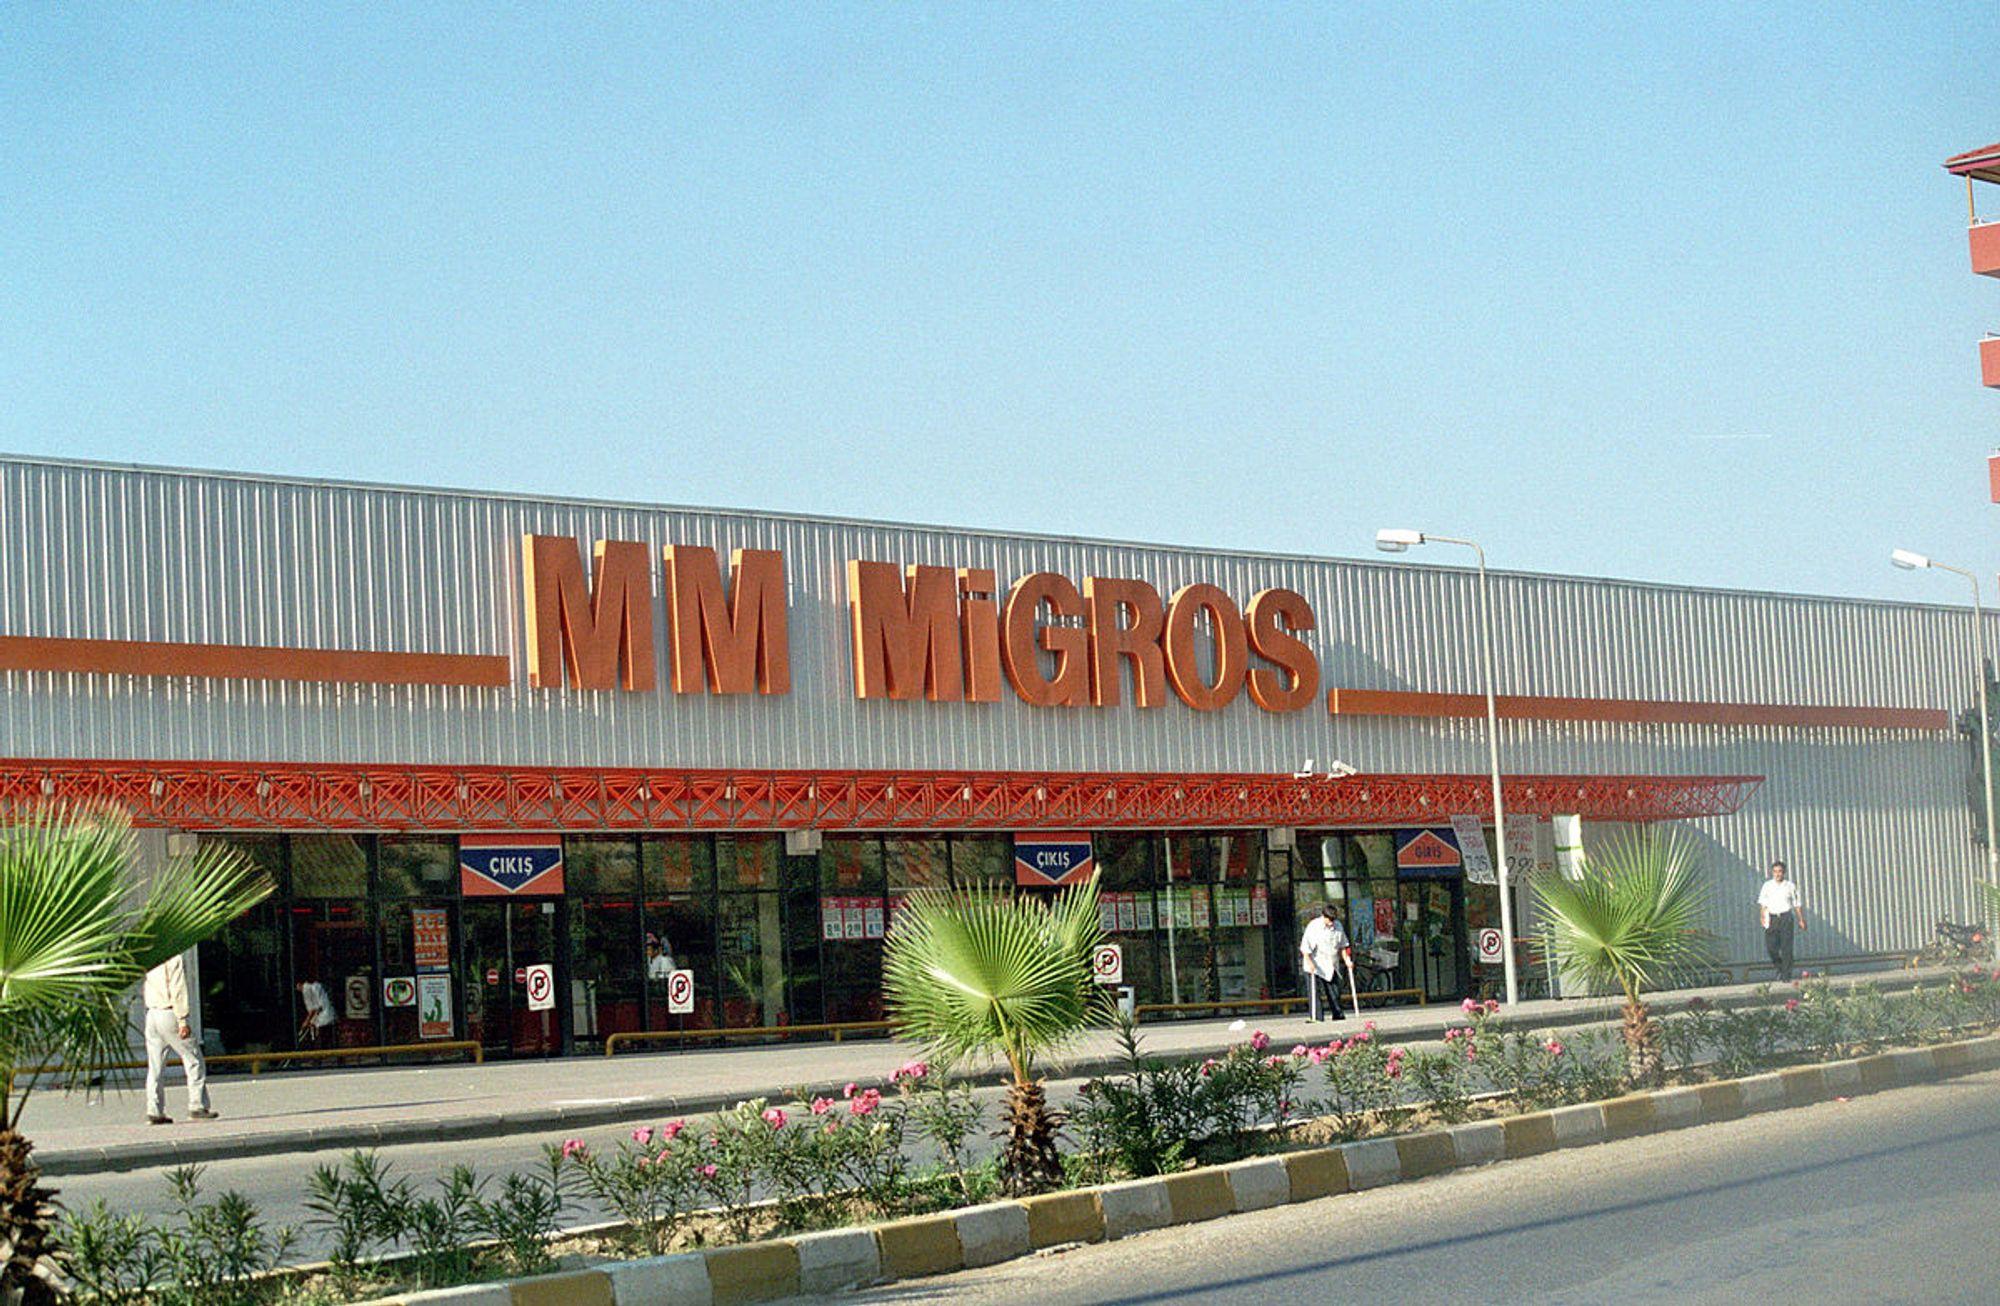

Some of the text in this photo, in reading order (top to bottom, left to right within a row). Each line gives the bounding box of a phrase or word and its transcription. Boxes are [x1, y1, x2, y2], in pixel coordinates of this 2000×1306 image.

[523, 533, 791, 697] MM
[489, 856, 534, 877] ÇIKIŞ
[1036, 850, 1070, 869] ÇIKIŞ
